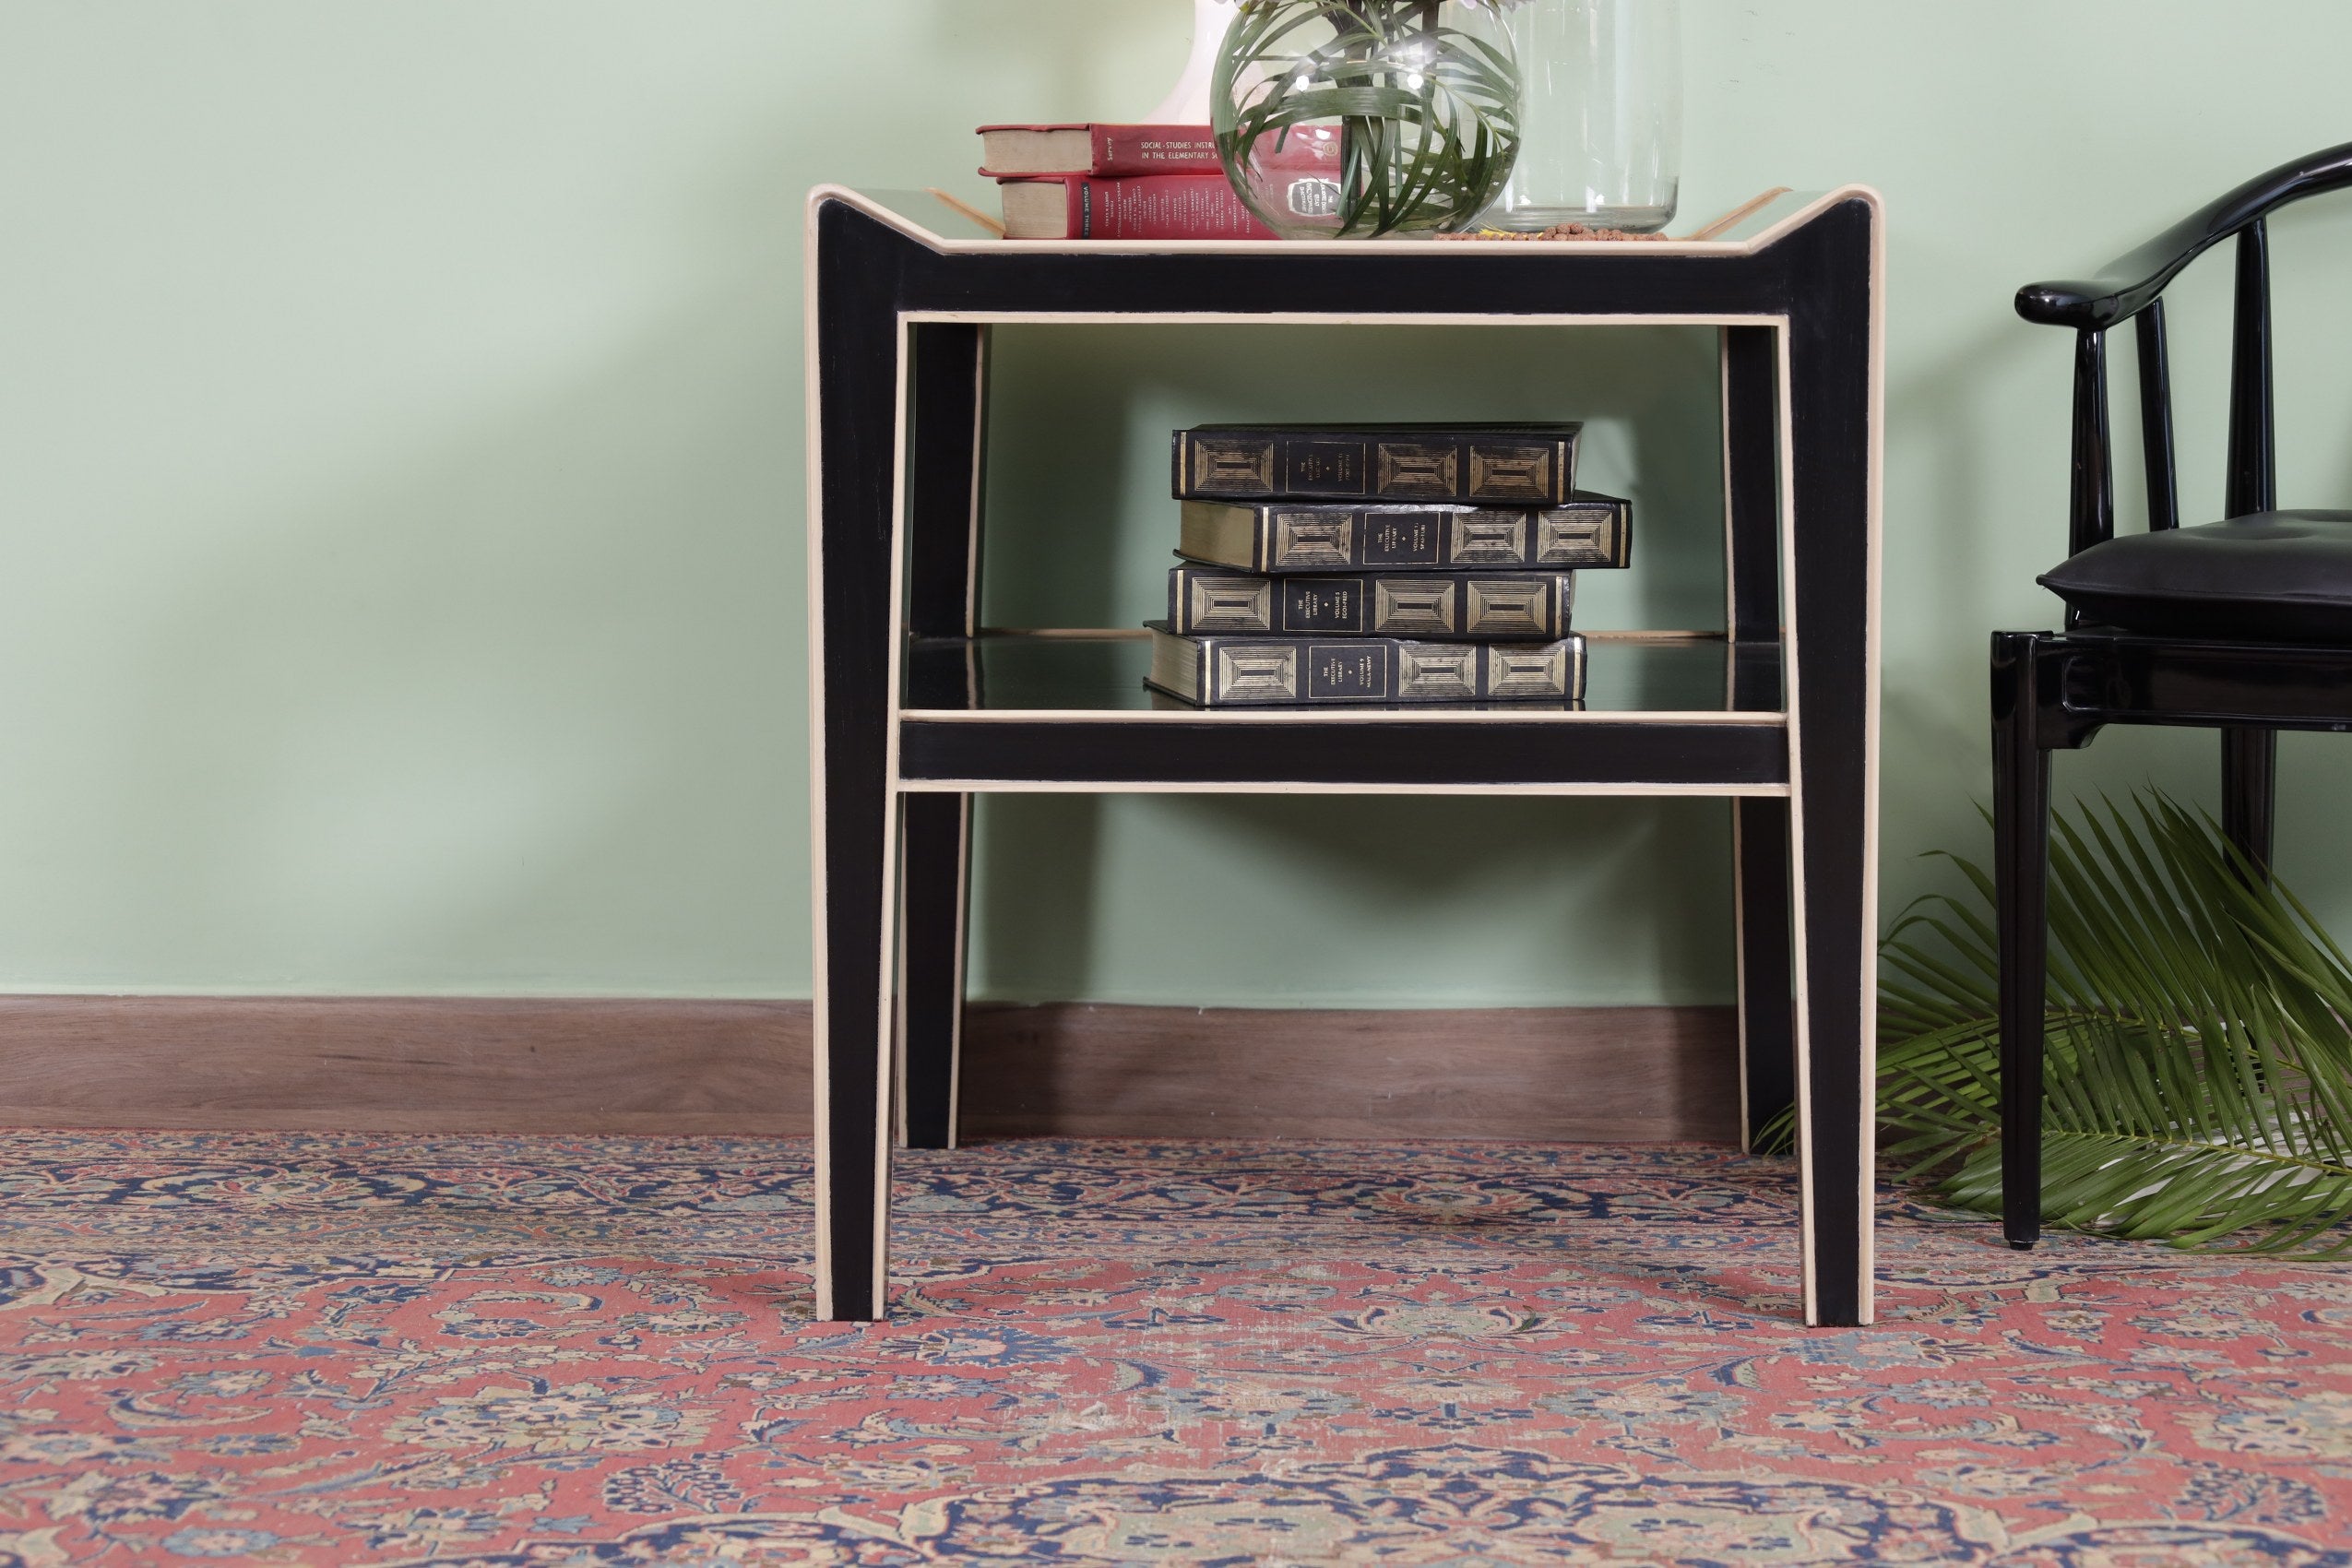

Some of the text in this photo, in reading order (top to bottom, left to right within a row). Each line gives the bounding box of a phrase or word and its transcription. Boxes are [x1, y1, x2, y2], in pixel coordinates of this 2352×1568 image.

[1141, 151, 1149, 160] IN
[1152, 151, 1165, 160] THE
[1168, 151, 1208, 160] ELEMENTARY
